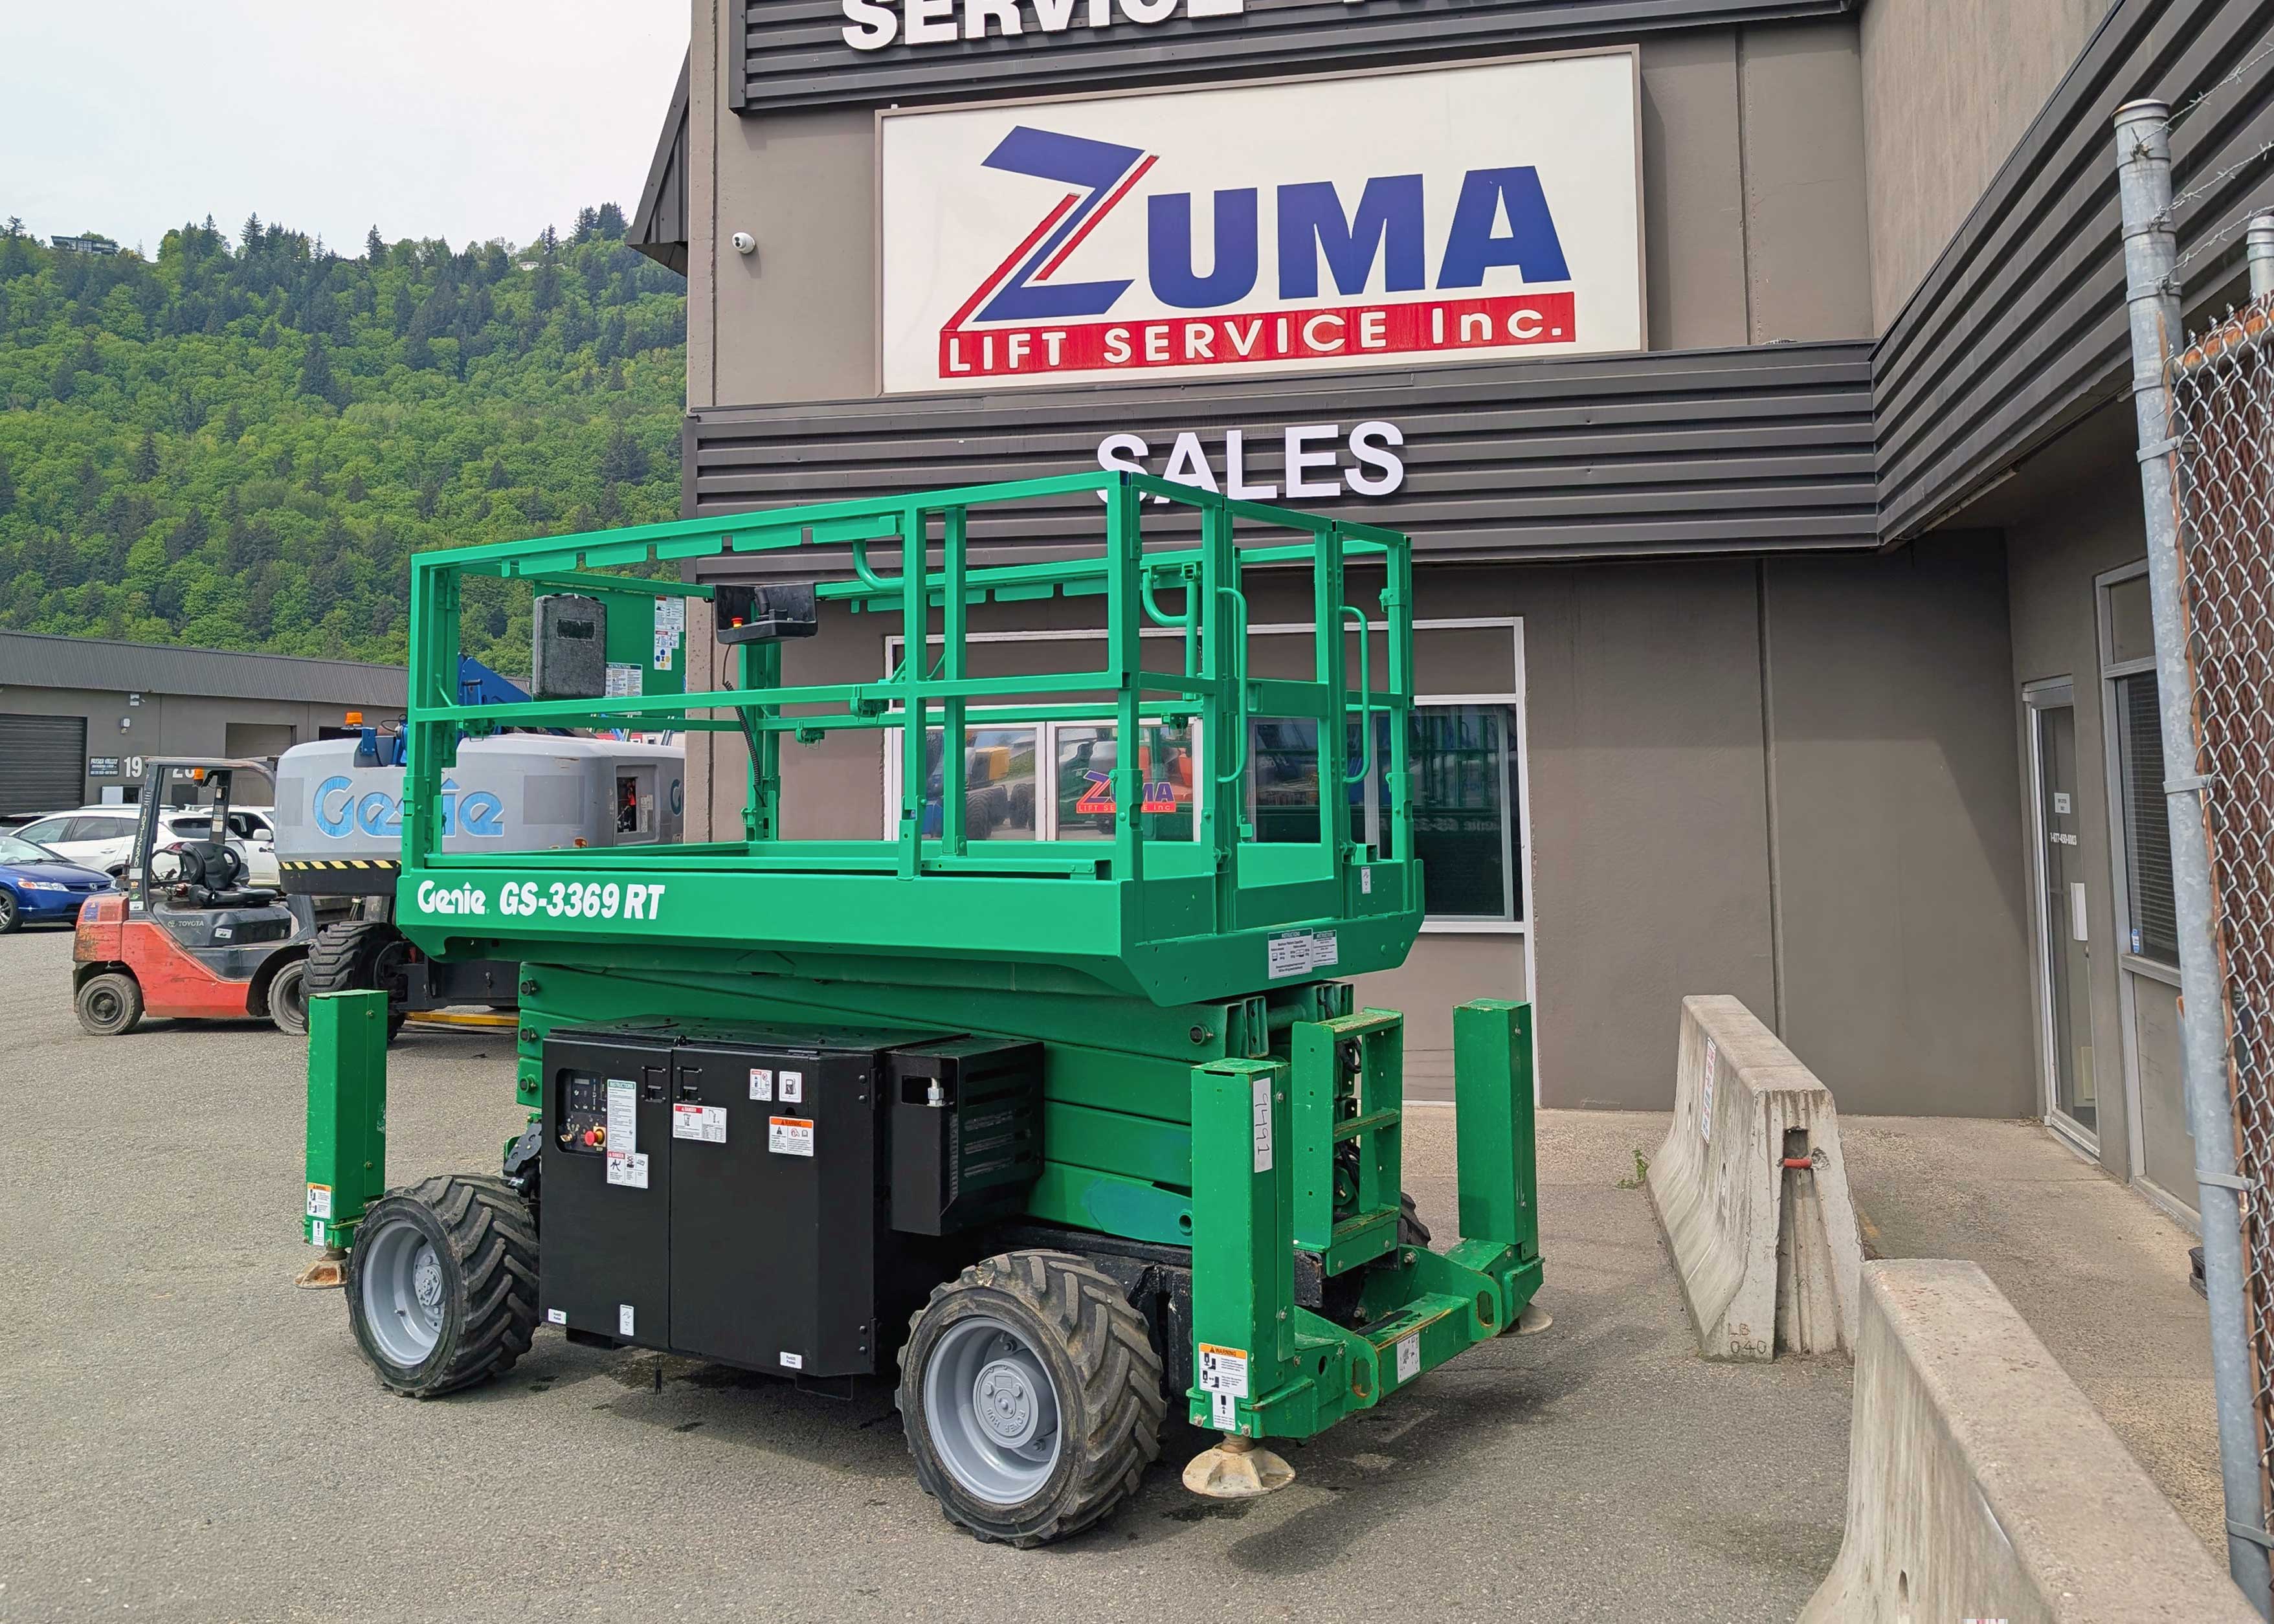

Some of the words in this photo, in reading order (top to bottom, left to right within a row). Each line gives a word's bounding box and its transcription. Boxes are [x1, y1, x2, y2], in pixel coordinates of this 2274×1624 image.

[842, 0, 1243, 50] SERV
[946, 126, 1572, 323] ZUMA
[950, 331, 1067, 372] LIFT
[1104, 311, 1387, 364] SERVICE
[1432, 307, 1562, 344] Inc.
[1097, 421, 1404, 504] SALES
[124, 757, 142, 777] 19
[313, 776, 504, 838] Geie
[417, 880, 486, 915] Genie
[500, 882, 620, 918] GS-3369
[623, 884, 666, 920] RT
[1216, 1348, 1236, 1357] WARNING
[1730, 1340, 1767, 1355] 040
